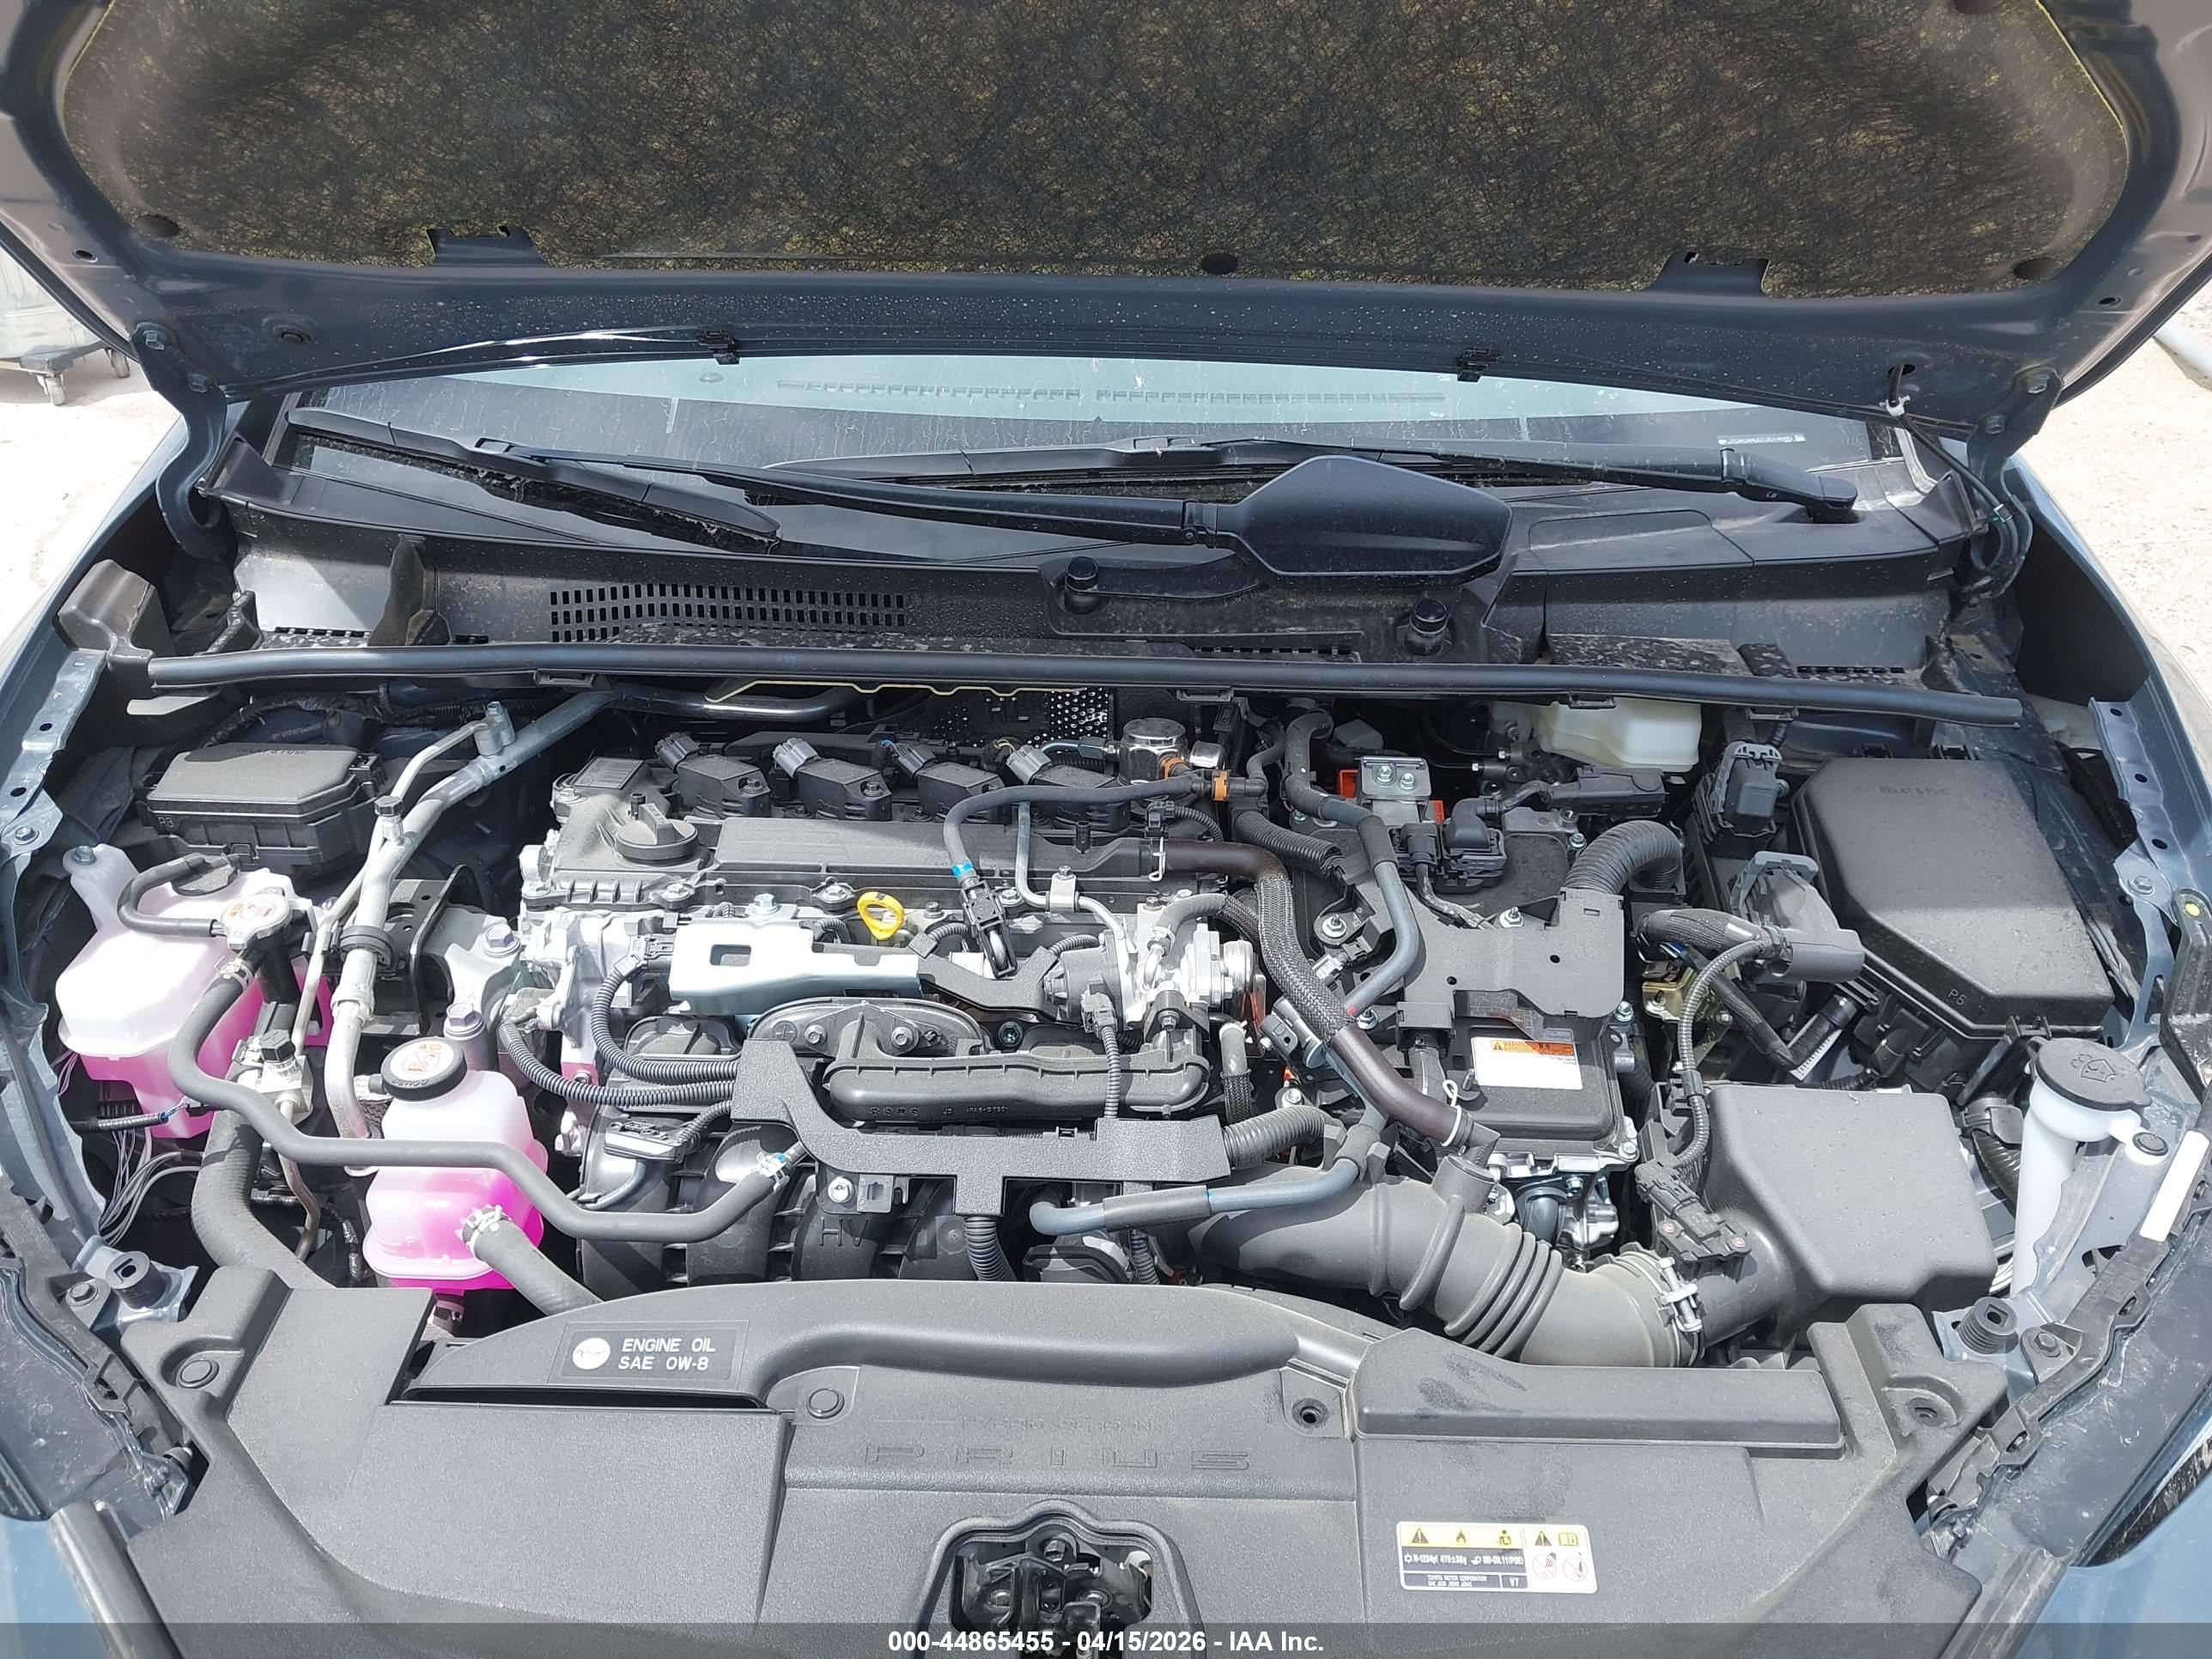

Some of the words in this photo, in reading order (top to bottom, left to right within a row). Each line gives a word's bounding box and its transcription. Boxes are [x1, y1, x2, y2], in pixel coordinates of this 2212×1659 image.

[819, 1218, 869, 1247] HV
[622, 1338, 682, 1352] ENGINE
[691, 1338, 716, 1352] OIL
[618, 1356, 654, 1370] SAE
[864, 1443, 1251, 1471] PRIUS
